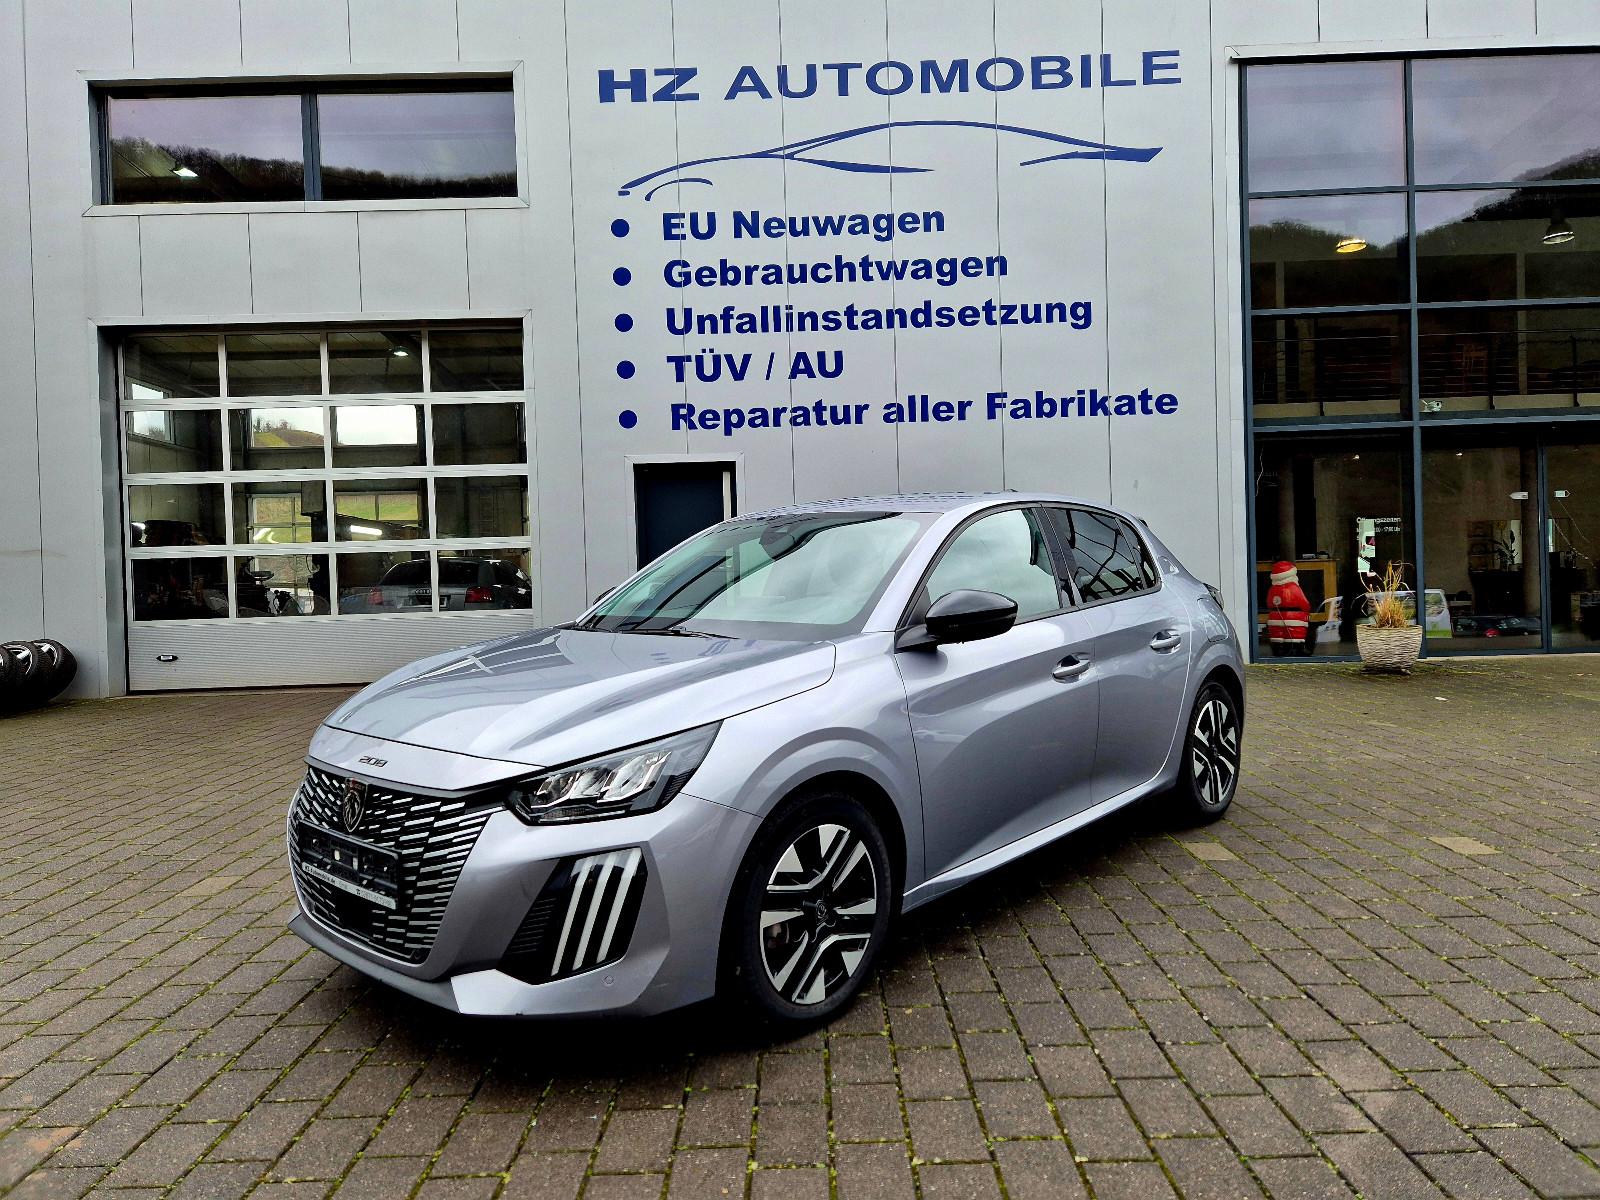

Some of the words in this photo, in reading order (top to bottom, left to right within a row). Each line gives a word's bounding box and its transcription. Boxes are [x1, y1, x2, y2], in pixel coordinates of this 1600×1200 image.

[598, 68, 700, 103] HZ
[725, 50, 1181, 100] AUTOMOBILE
[662, 211, 717, 241] EU
[732, 210, 946, 242] Neuwagen
[663, 255, 1008, 288] Gebrauchtwagen
[666, 300, 1093, 335] Unfallinstandsetzung
[666, 348, 752, 383] TÜV
[765, 352, 775, 381] /
[788, 351, 844, 380] AU
[671, 400, 870, 436] Reparatur
[882, 394, 973, 423] aller
[986, 388, 1179, 421] Fabrikate
[358, 755, 388, 768] 208
